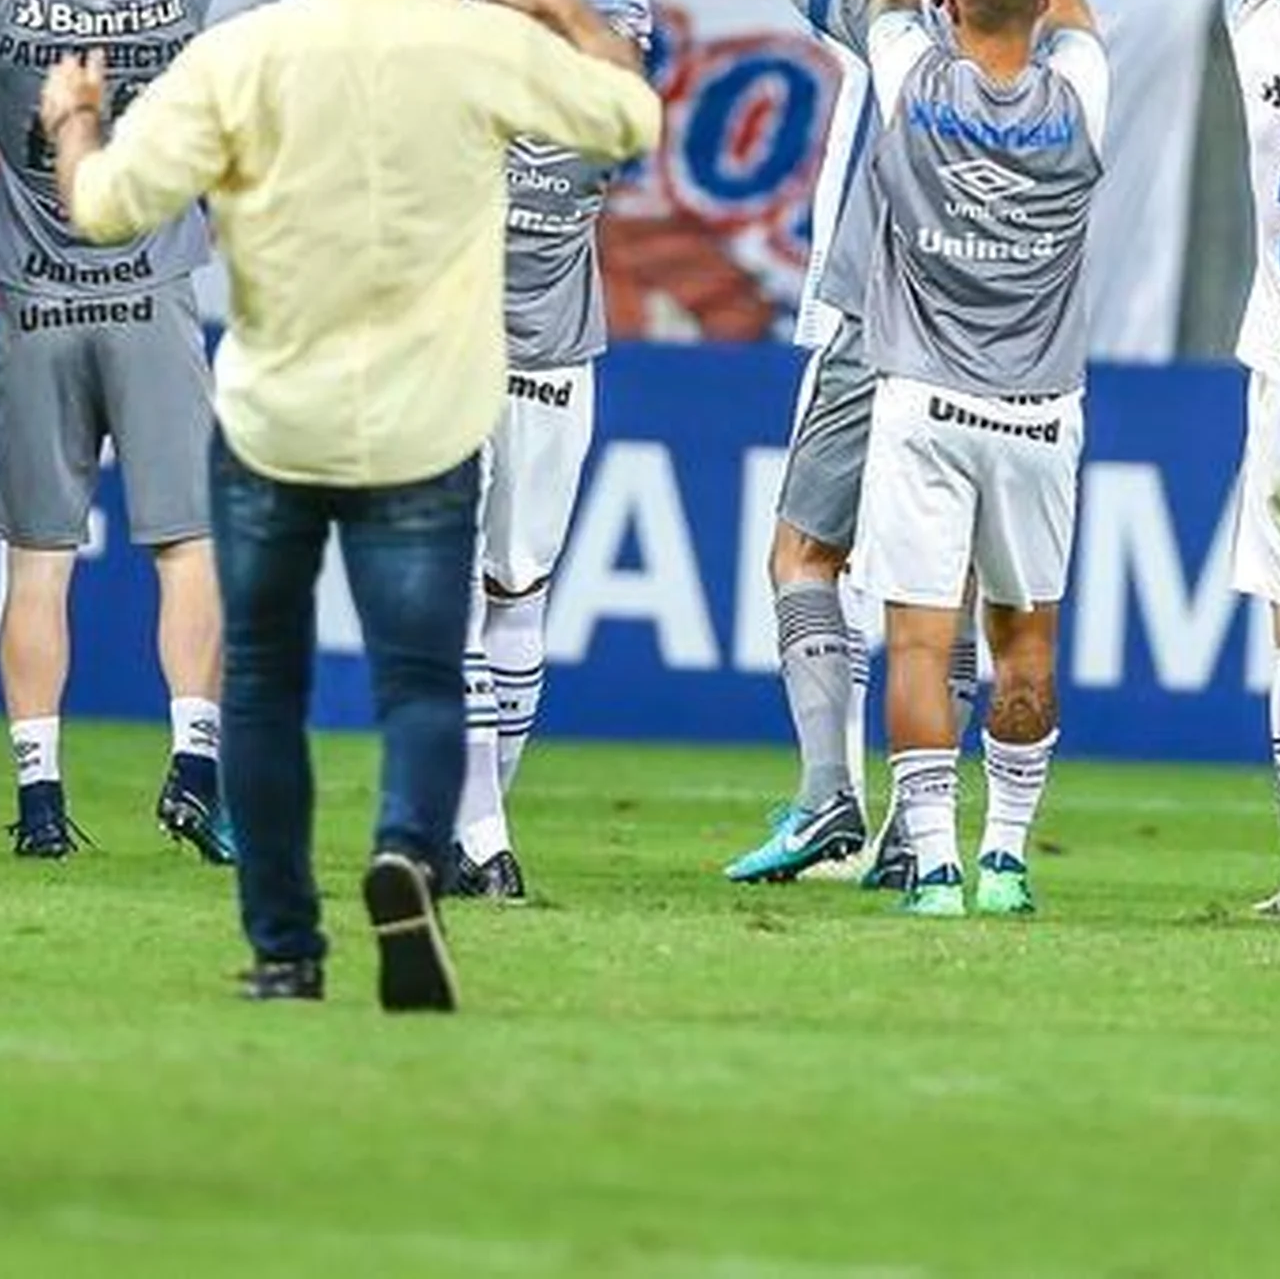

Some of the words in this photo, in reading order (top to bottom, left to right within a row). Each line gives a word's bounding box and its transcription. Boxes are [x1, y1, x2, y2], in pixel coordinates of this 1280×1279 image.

[506, 168, 570, 193] mbro
[510, 209, 581, 232] med
[919, 228, 1056, 260] Unimed
[23, 251, 153, 283] Unimed
[18, 296, 153, 332] Unimed
[507, 374, 573, 408] med
